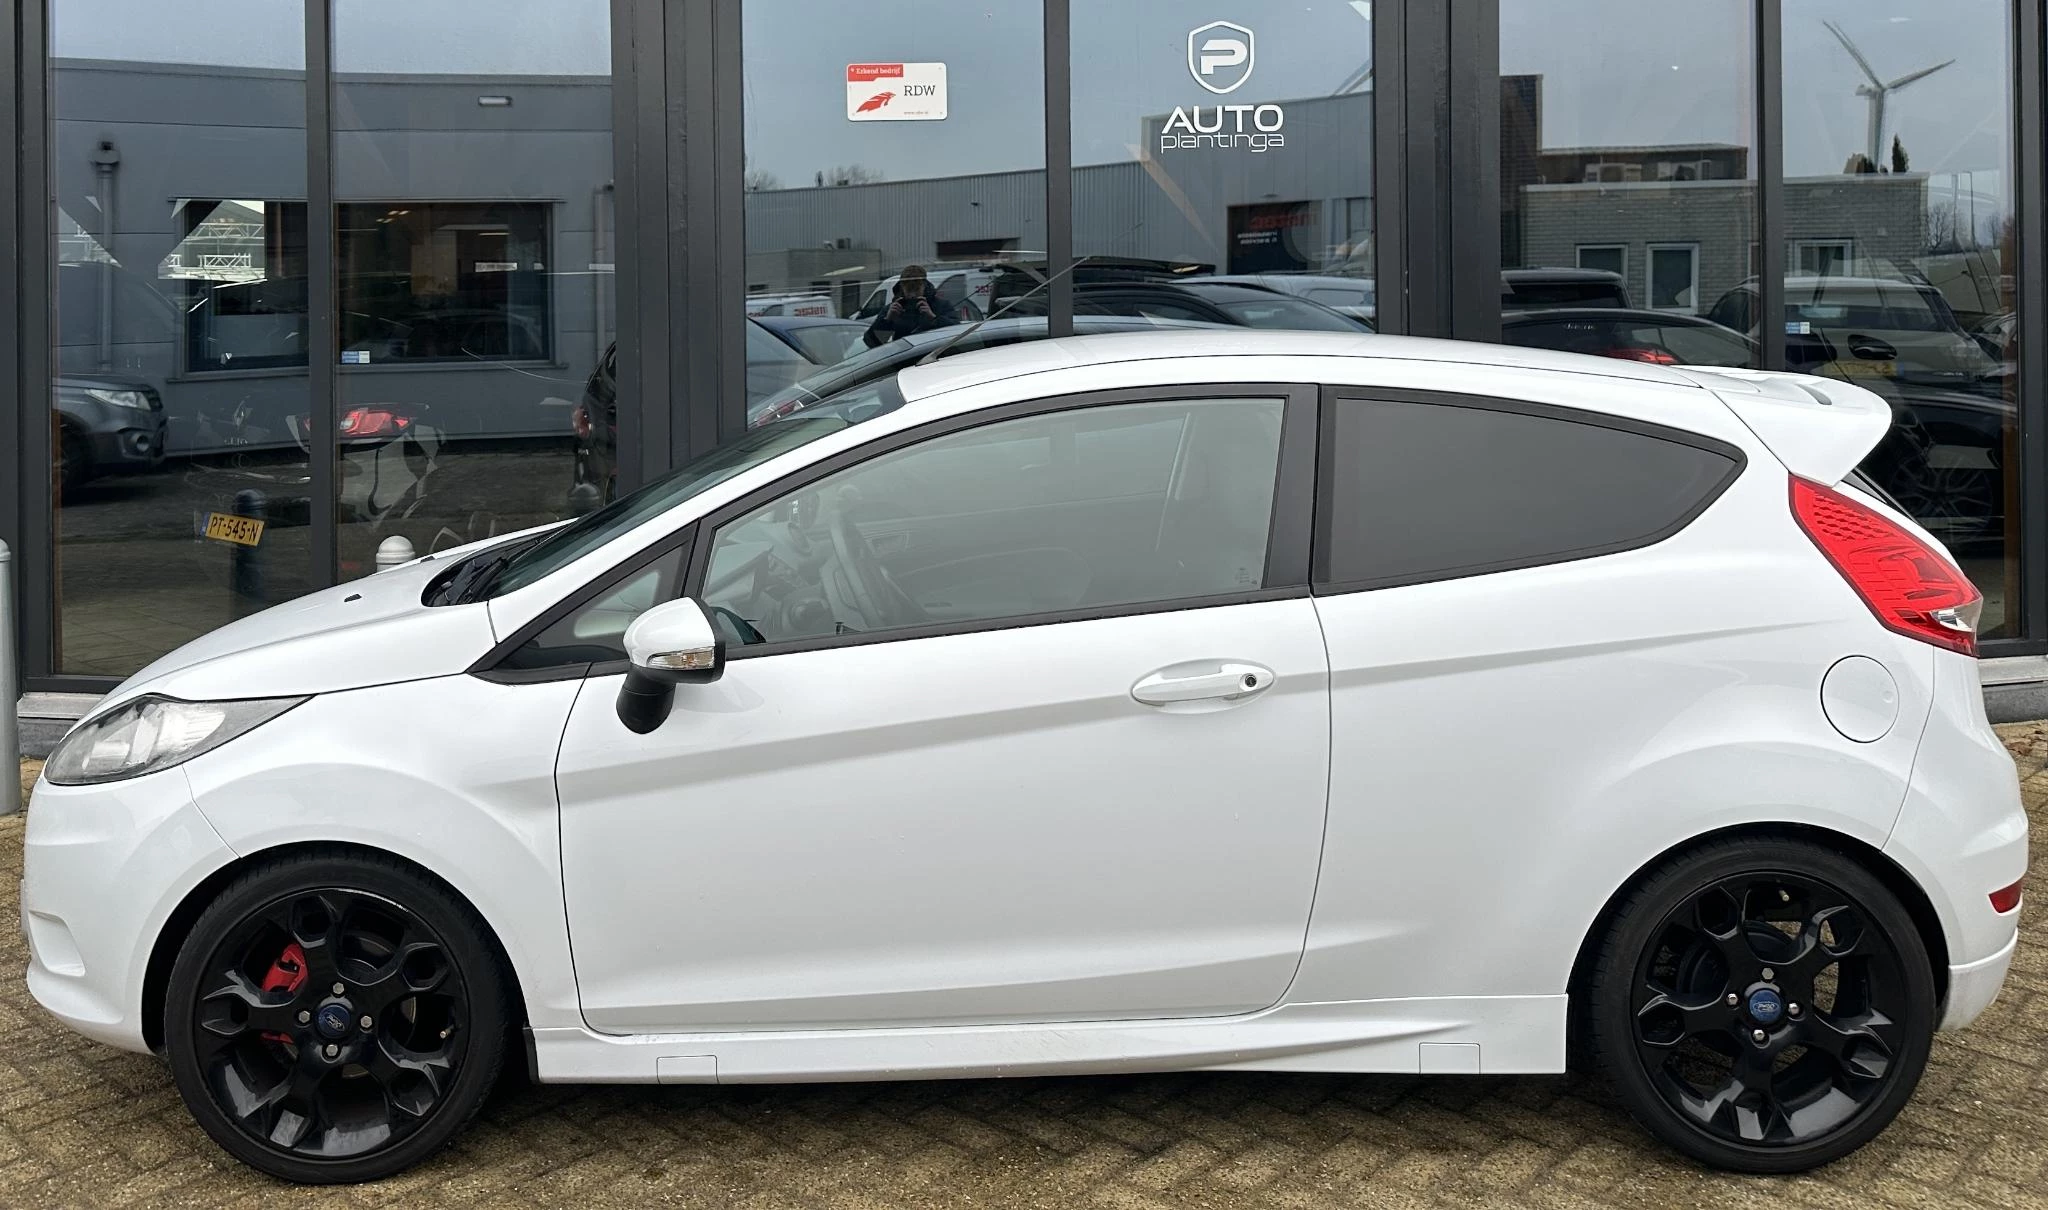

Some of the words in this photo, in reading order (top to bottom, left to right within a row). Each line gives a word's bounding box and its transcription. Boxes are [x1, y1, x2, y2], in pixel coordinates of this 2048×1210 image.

[1200, 39, 1248, 75] P
[879, 67, 900, 75] bedrijf
[903, 85, 936, 97] RDW
[1161, 104, 1284, 134] AUTO
[1160, 132, 1285, 154] plantinga
[209, 515, 260, 542] PT-545-N
